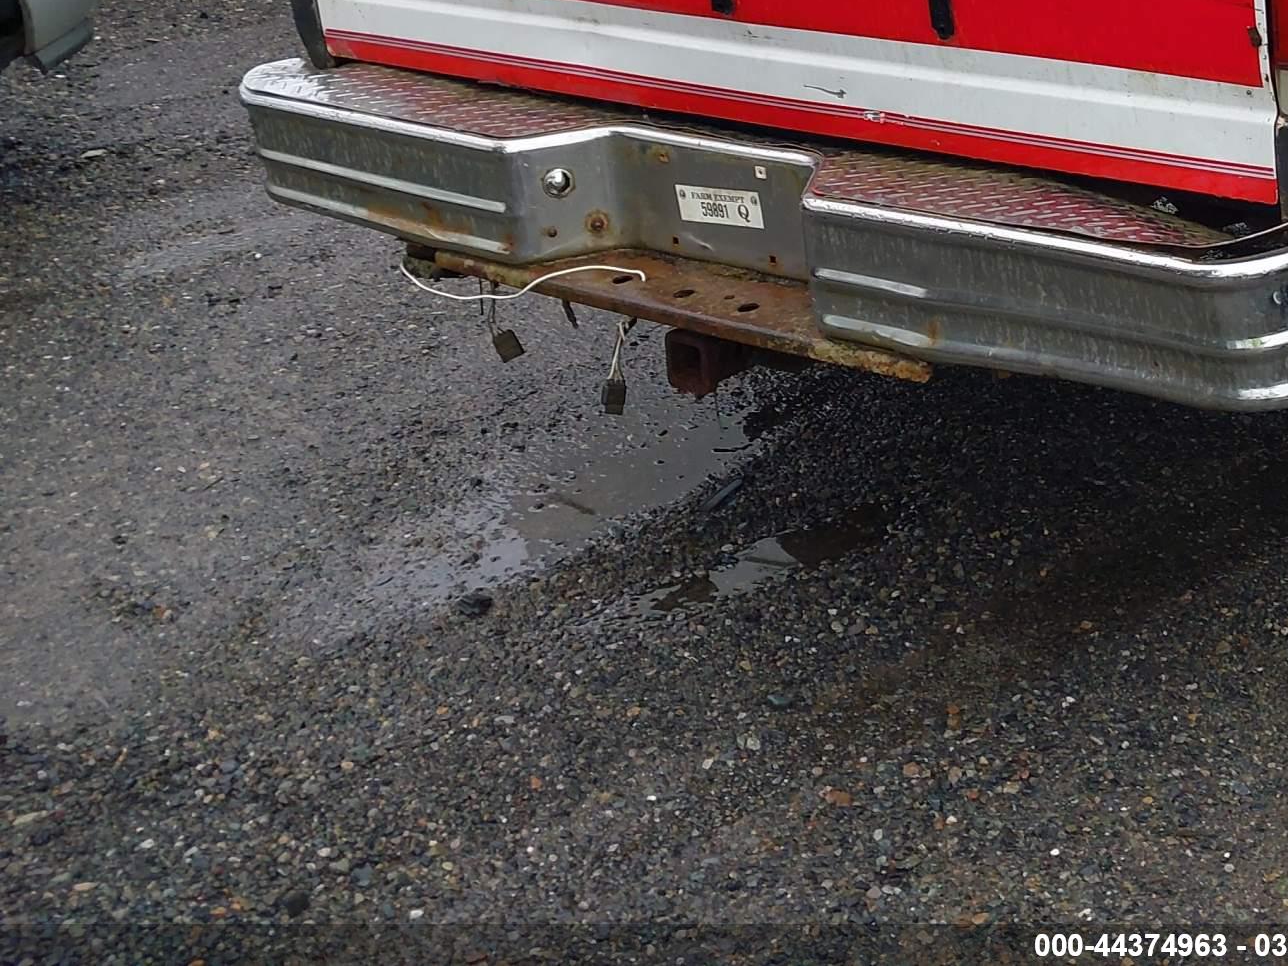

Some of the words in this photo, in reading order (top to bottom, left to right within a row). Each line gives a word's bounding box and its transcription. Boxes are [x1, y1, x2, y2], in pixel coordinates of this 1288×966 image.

[690, 191, 713, 201] FARM
[714, 194, 745, 203] EXEMPT
[700, 202, 730, 218] 59891
[737, 204, 751, 222] Q
